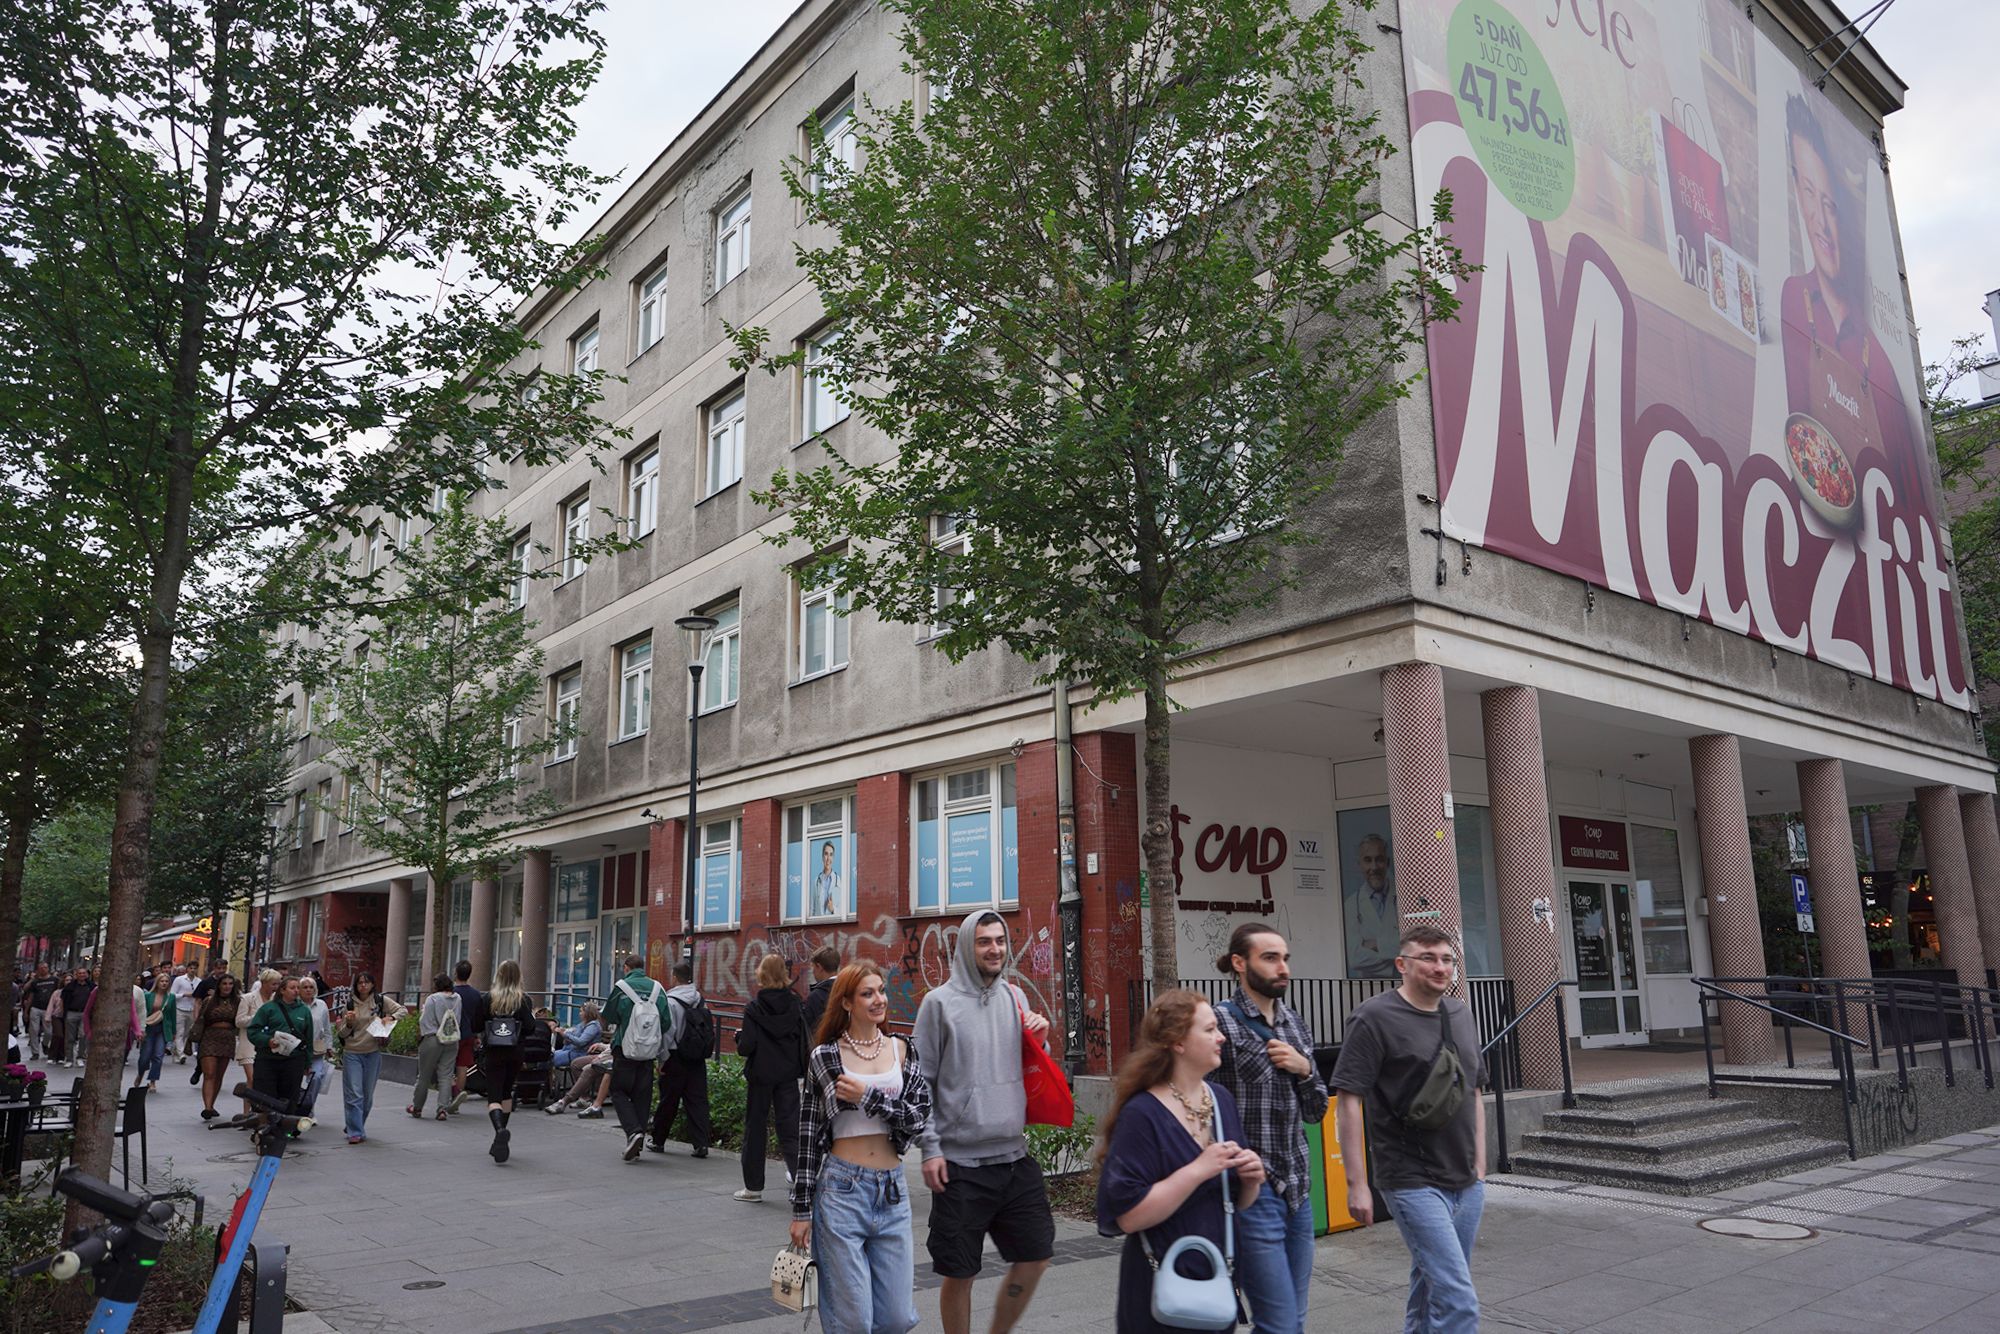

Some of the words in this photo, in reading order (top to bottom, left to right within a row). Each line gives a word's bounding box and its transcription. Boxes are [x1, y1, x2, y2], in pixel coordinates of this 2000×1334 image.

[1473, 14, 1484, 36] 5
[1486, 19, 1522, 52] DAŃ
[1480, 41, 1505, 68] JUŻ
[1506, 53, 1528, 76] OD
[1411, 120, 1971, 712] Maczfit
[1570, 846, 1595, 858] CENTRUM
[1794, 878, 1806, 902] P
